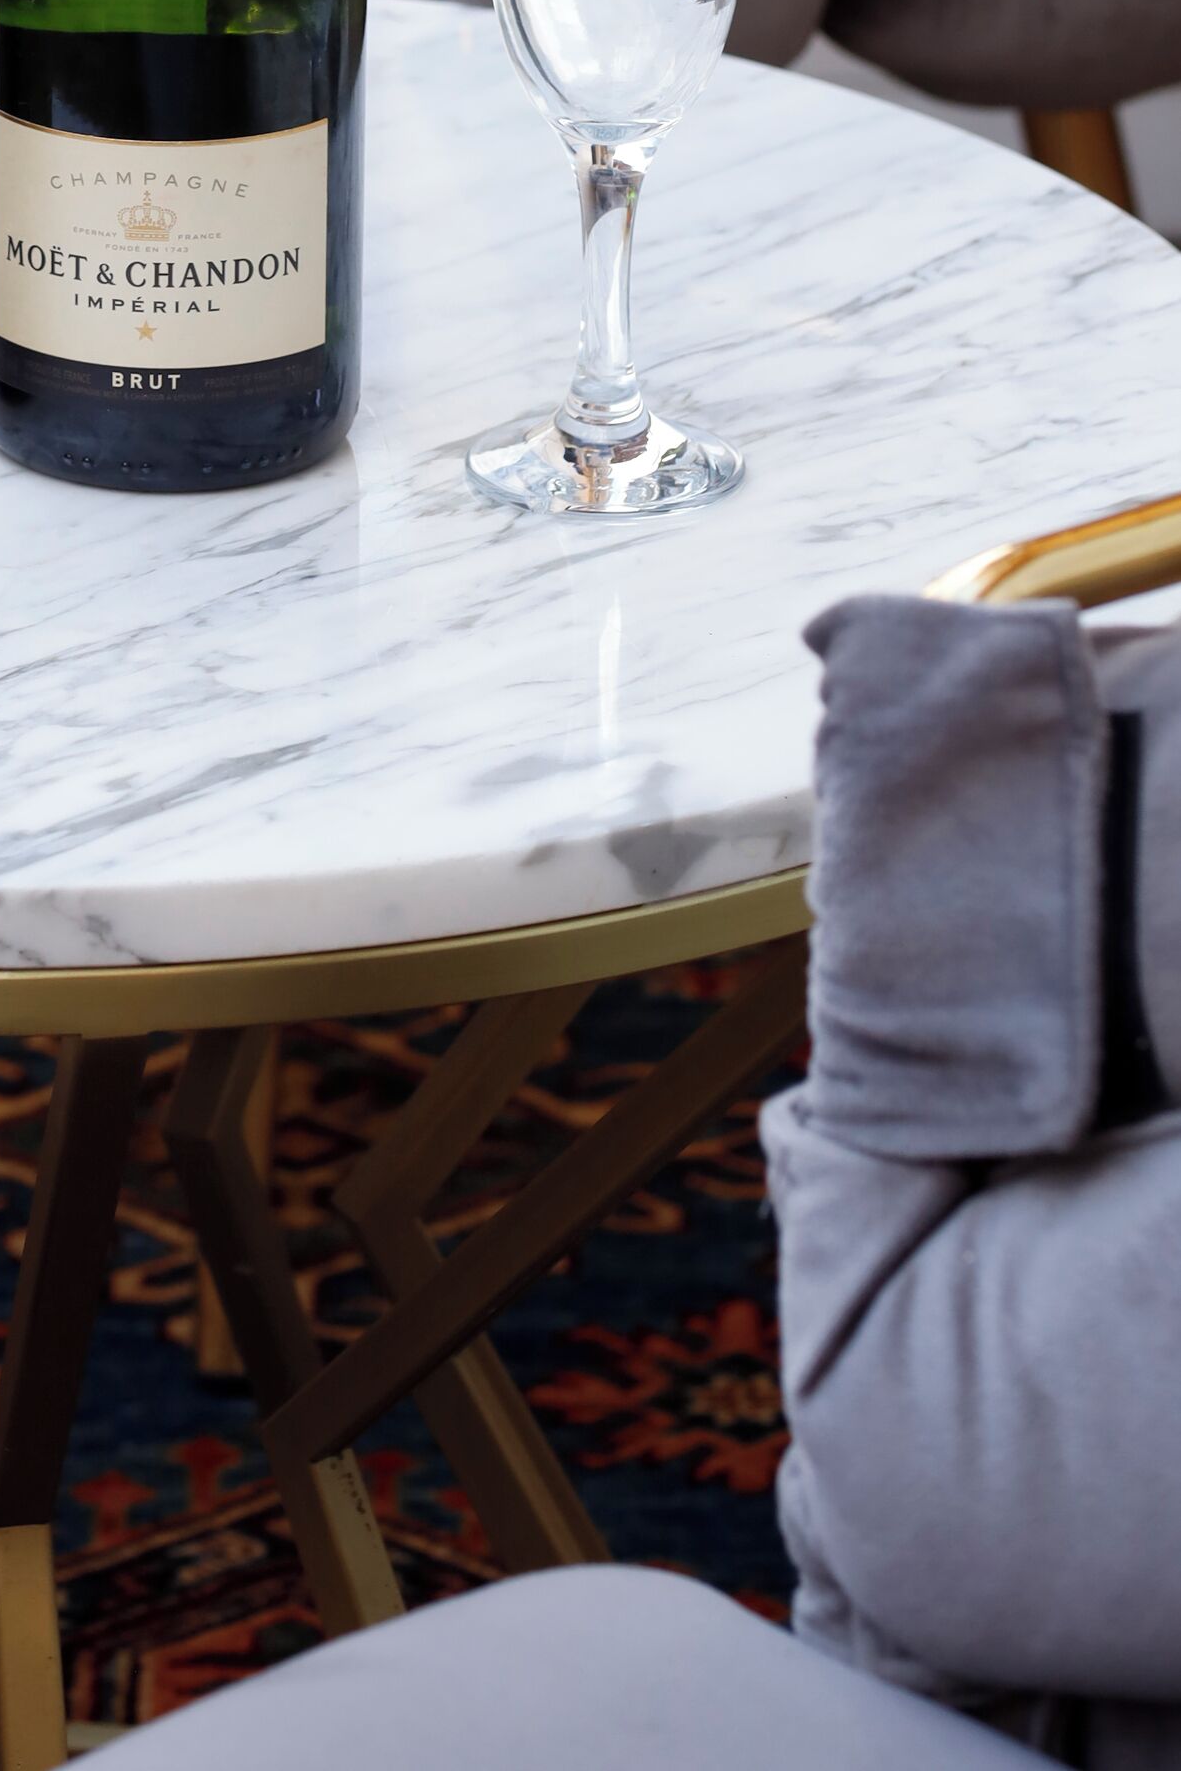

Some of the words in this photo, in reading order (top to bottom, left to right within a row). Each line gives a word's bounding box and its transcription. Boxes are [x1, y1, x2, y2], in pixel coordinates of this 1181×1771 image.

[50, 171, 250, 198] CHAMPAGNE
[178, 232, 222, 240] FRANCE
[6, 235, 88, 280] MOËT
[96, 262, 116, 286] &
[124, 246, 301, 289] CHANDON
[74, 292, 221, 314] IMPÉRIAL
[111, 371, 182, 391] BRUT
